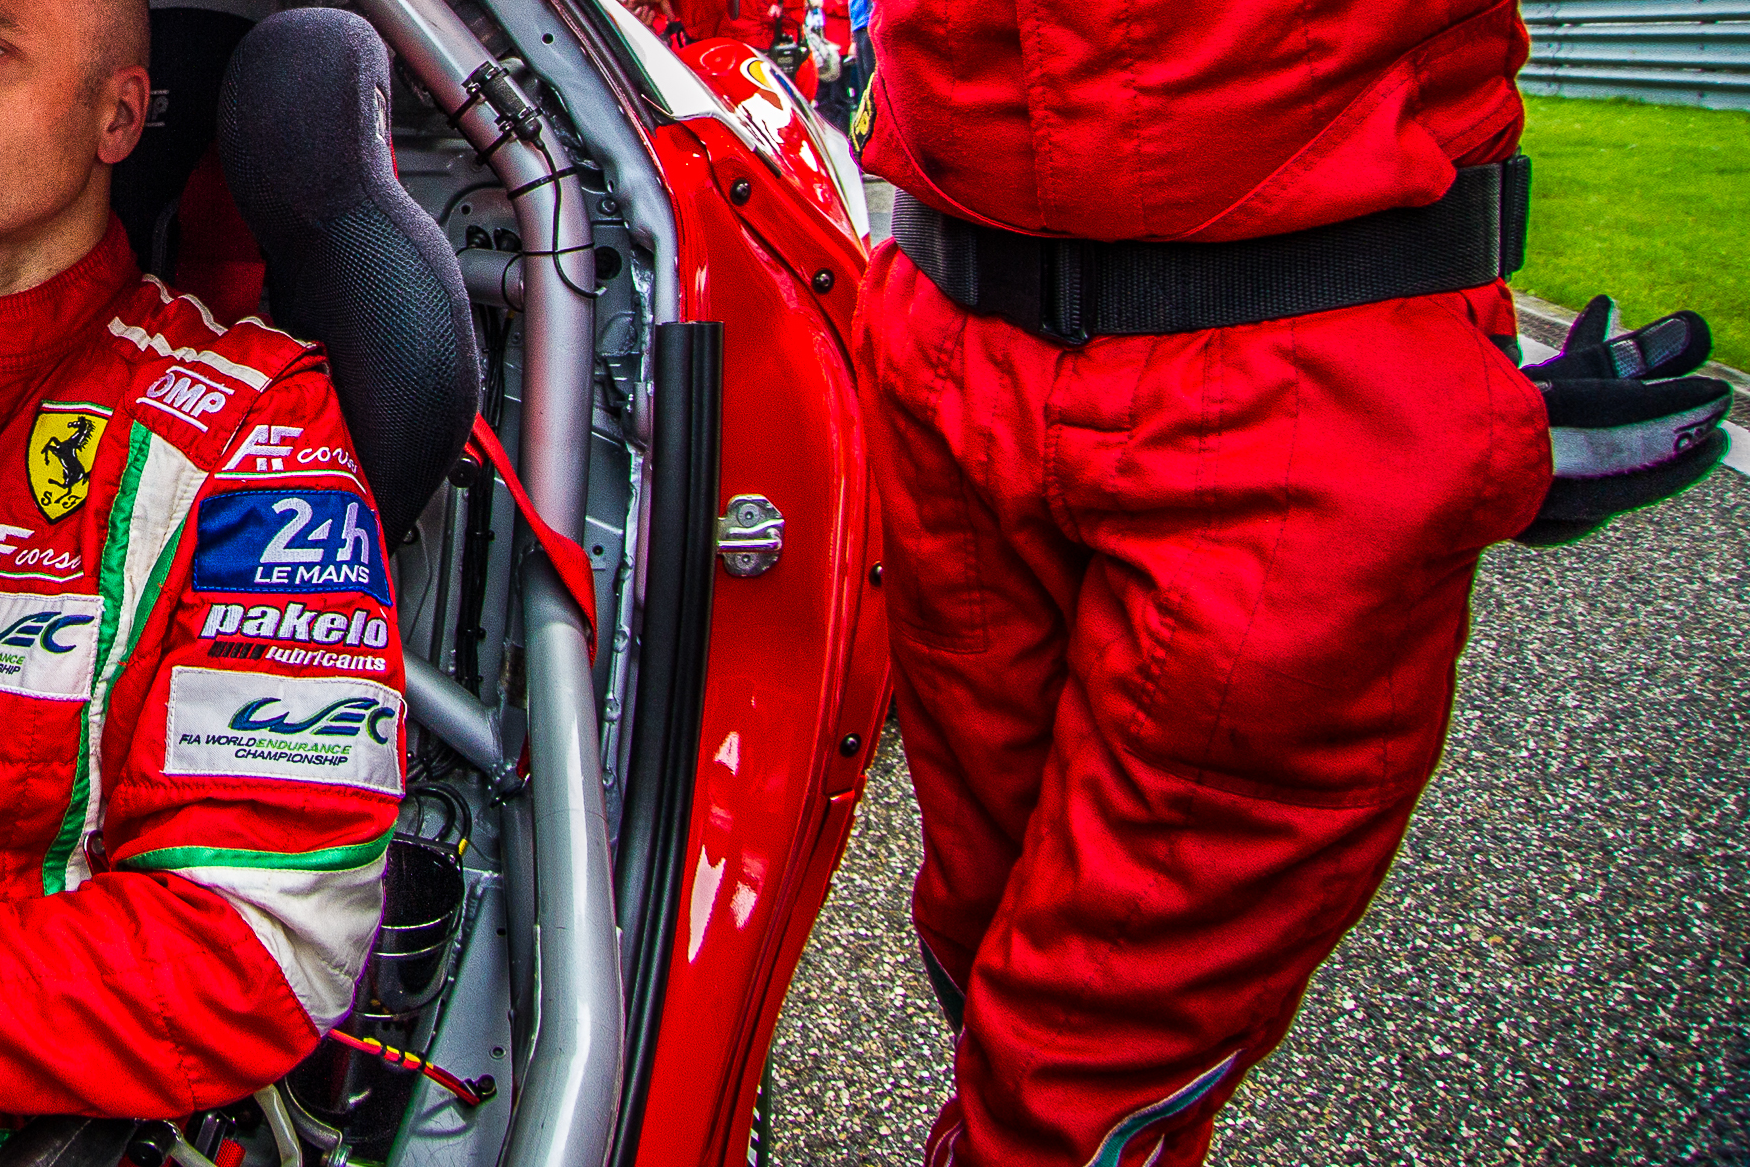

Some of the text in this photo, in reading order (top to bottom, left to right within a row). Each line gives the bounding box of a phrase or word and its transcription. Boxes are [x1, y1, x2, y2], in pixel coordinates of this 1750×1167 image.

[147, 372, 227, 418] OMP
[220, 424, 305, 471] AF
[40, 491, 82, 509] S F
[258, 497, 370, 565] 24h
[254, 565, 370, 584] LE MANS
[199, 601, 389, 650] pakelo
[265, 645, 387, 672] lubricants
[228, 697, 396, 745] WEC
[178, 733, 201, 746] FIA
[234, 748, 349, 766] CHAMPIONSHIP
